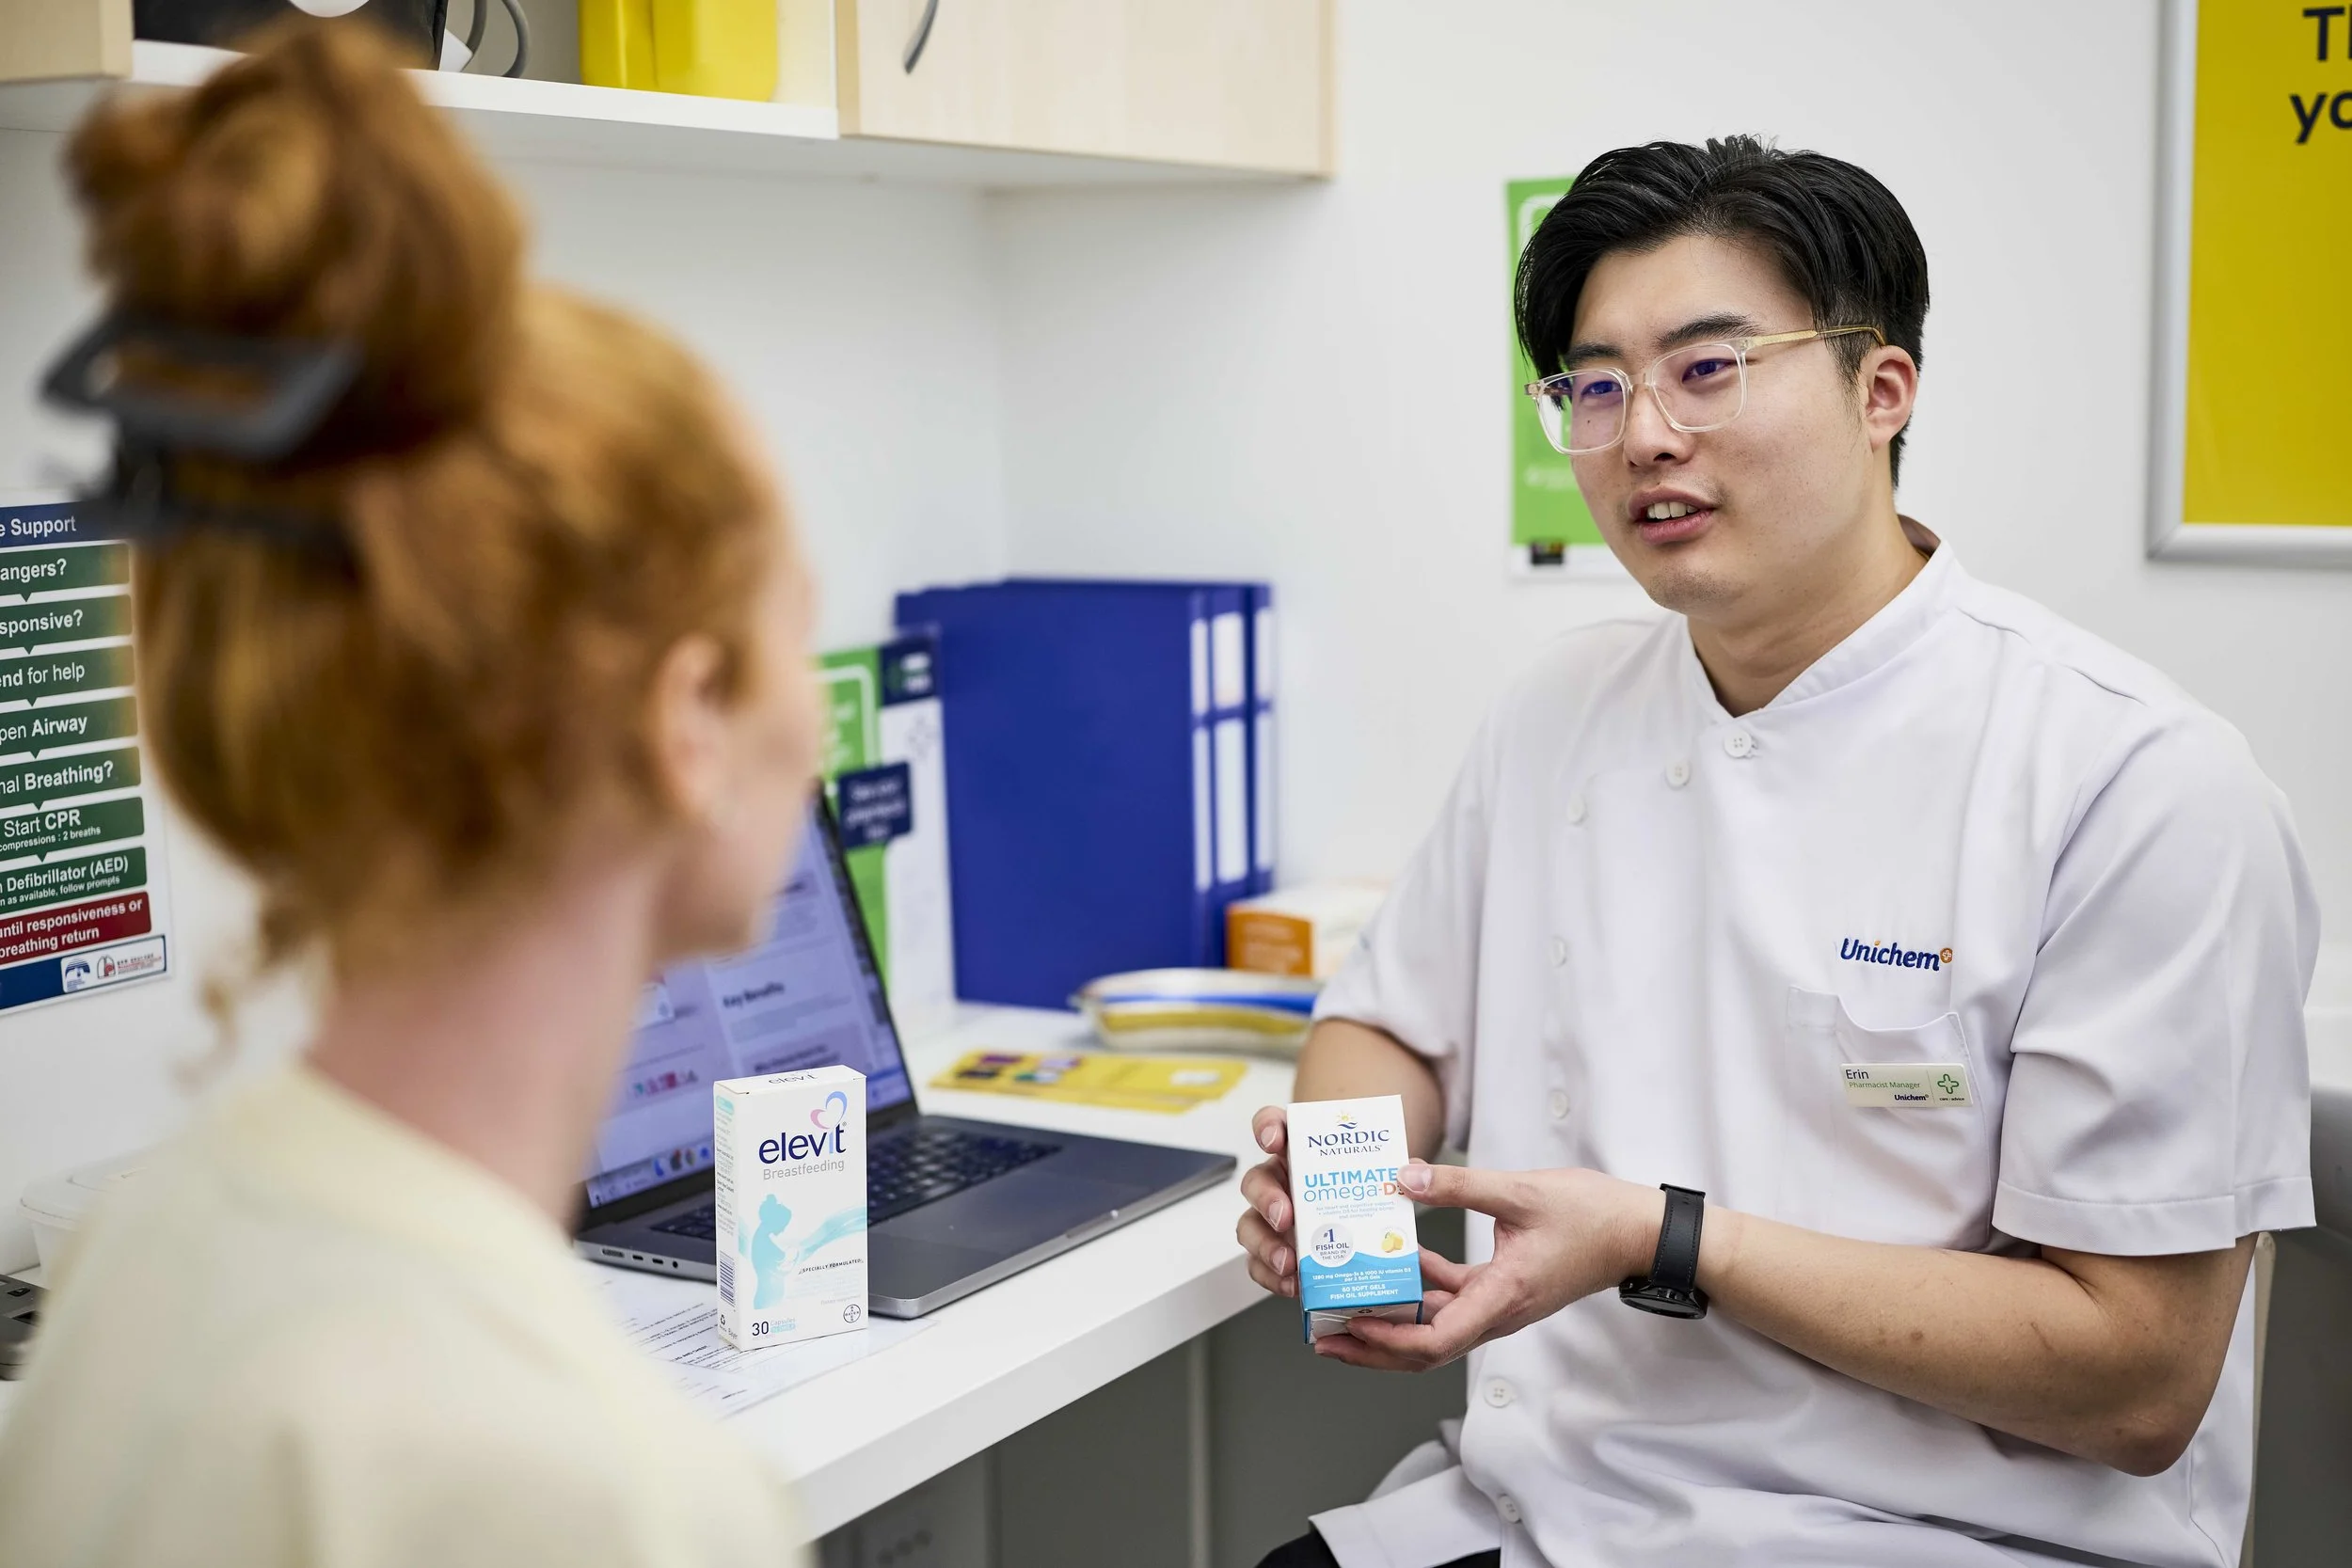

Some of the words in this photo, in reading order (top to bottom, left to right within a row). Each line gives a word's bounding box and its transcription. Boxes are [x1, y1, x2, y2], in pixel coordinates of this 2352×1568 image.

[2302, 5, 2352, 63] T
[10, 515, 77, 538] Support
[26, 666, 49, 685] for
[52, 662, 86, 682] help
[31, 716, 87, 737] Airway
[24, 760, 114, 791] Breathing?
[4, 816, 41, 838] Start
[44, 809, 82, 831] CPR
[62, 831, 69, 841] 2
[70, 825, 102, 840] breaths
[7, 864, 87, 893] Defibrillator
[89, 855, 129, 879] (AED)
[8, 896, 18, 906] as
[59, 881, 86, 895] follow
[87, 876, 120, 892] prompts
[26, 903, 126, 933] responsiveness
[129, 898, 143, 912] or
[61, 927, 100, 945] return
[1840, 938, 1940, 972] Unichem
[1845, 1069, 1869, 1080] Erin
[1889, 1081, 1920, 1090] Manager
[758, 1123, 847, 1164] elevit
[1308, 1130, 1391, 1148] NORDIC
[1320, 1145, 1381, 1156] NATURALS
[763, 1160, 845, 1180] Breastfeeding
[1304, 1167, 1399, 1188] ULTIMATE
[1315, 1243, 1334, 1252] FISH
[1336, 1242, 1350, 1250] OIL
[803, 1264, 829, 1274] SPECIALLY
[829, 1259, 861, 1268] FORMULATED
[1358, 1289, 1399, 1298] SUPPLEMENT
[752, 1321, 770, 1337] 30
